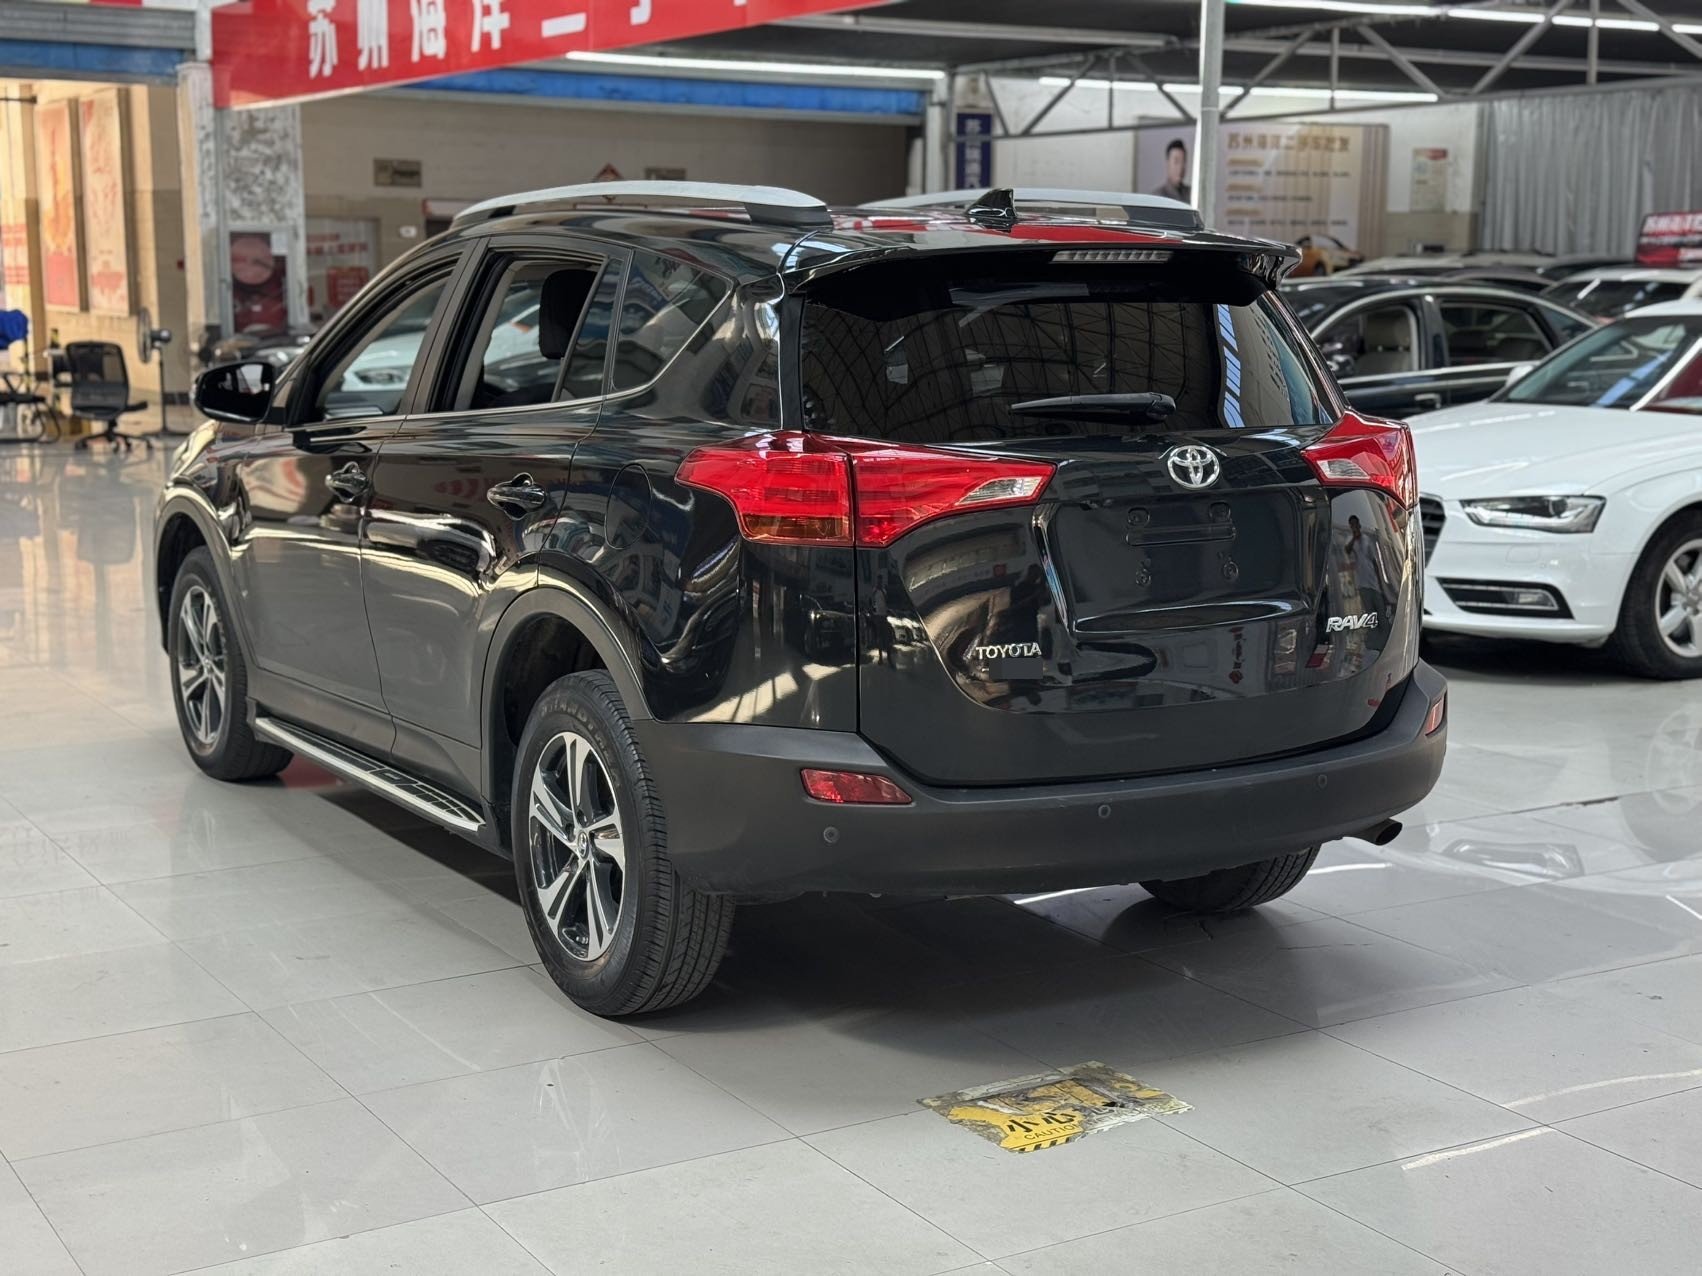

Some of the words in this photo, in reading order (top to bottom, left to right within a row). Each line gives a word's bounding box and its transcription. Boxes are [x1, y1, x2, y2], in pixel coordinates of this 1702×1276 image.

[1326, 612, 1379, 633] RAV4
[975, 642, 1042, 660] TOYOTA
[1006, 1112, 1077, 1133] 小心
